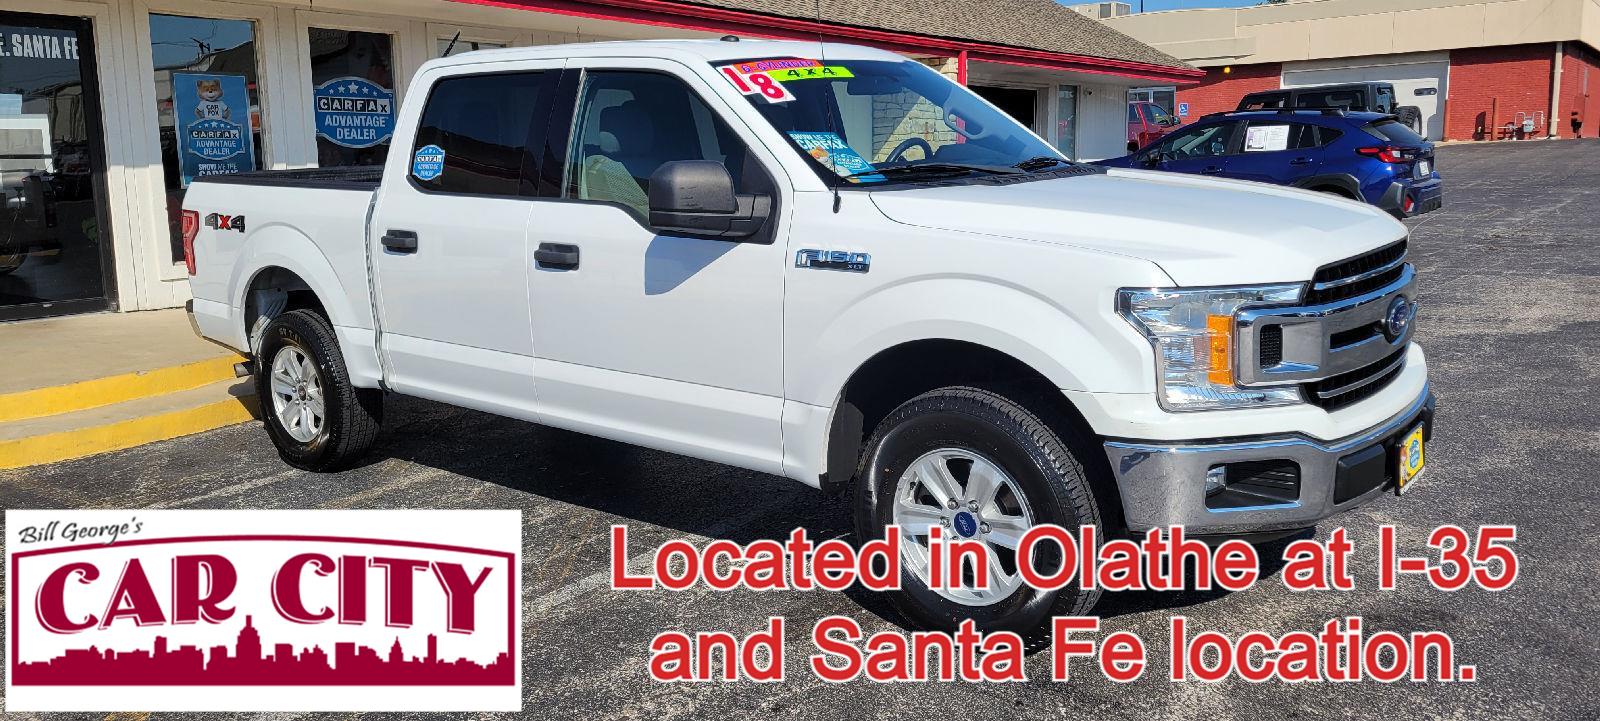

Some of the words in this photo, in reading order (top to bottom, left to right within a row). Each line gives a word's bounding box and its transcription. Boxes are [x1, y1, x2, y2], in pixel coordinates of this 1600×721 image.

[11, 33, 62, 59] SANTA
[63, 36, 80, 60] FE
[317, 98, 390, 114] CARFAX
[325, 114, 386, 127] ADVANTAGE
[192, 130, 240, 139] CARFAX
[336, 128, 377, 140] DEALER
[196, 140, 237, 148] ADVANTAGE
[203, 147, 230, 156] DEALER
